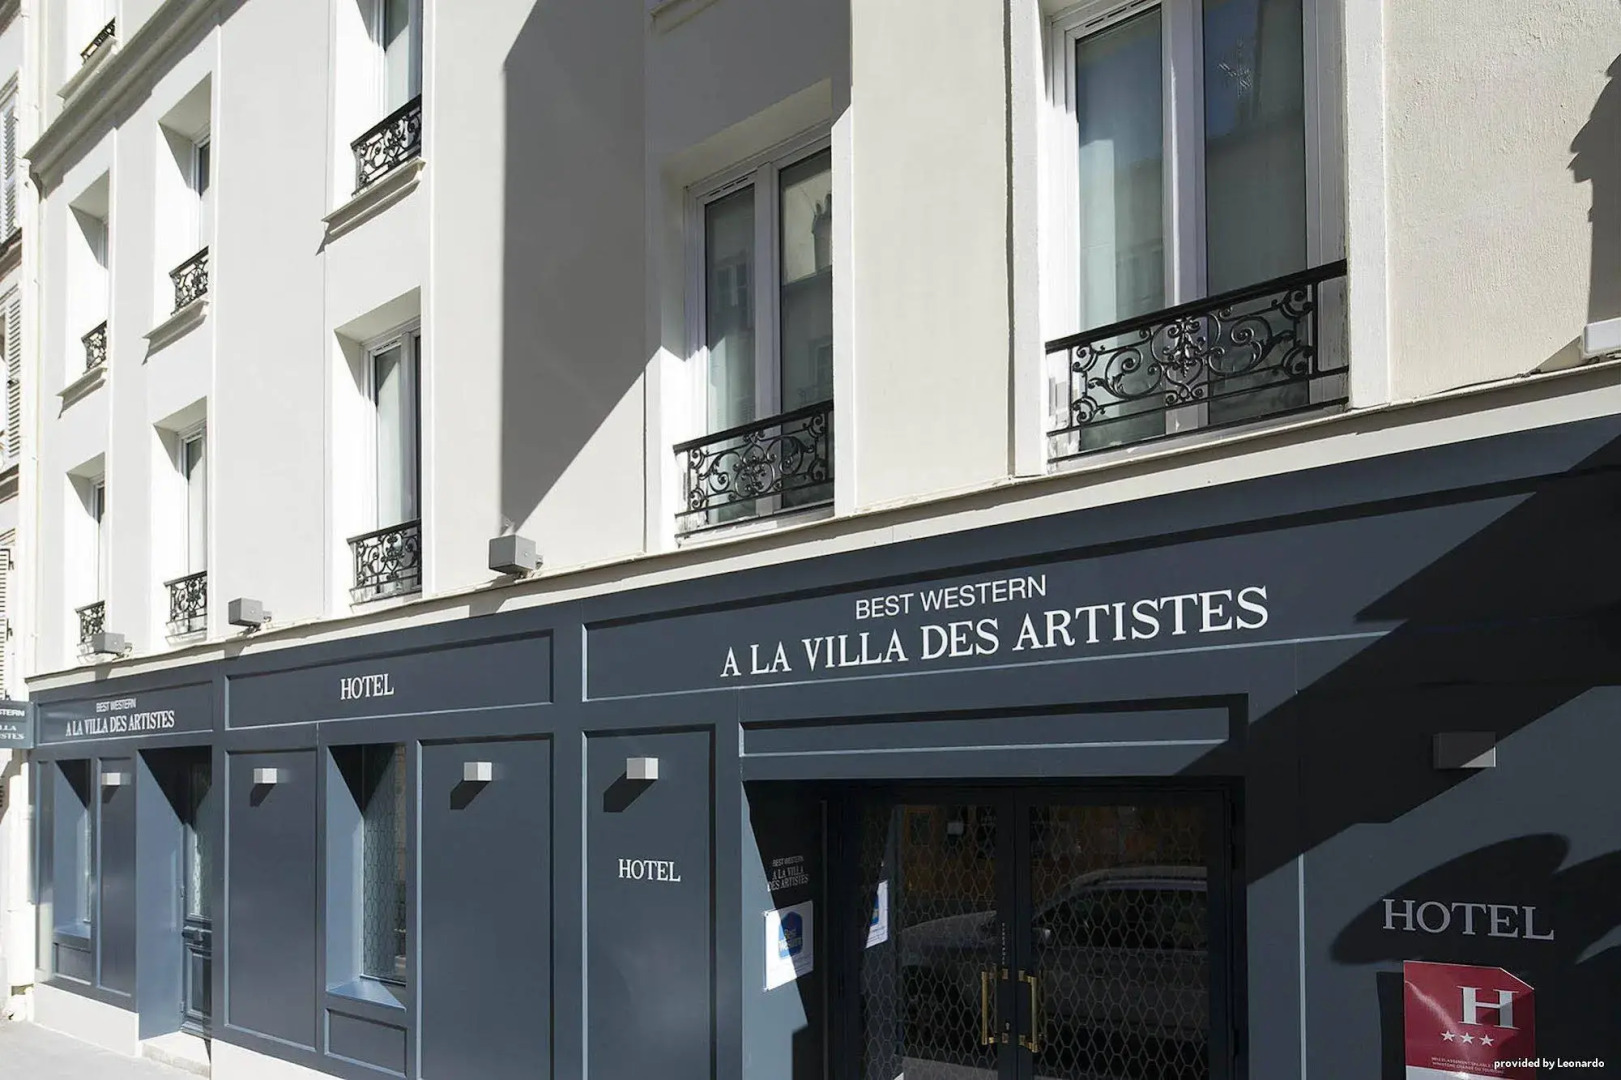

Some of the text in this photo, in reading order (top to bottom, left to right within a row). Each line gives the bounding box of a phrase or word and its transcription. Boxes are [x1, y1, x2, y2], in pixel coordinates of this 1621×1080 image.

[856, 574, 1046, 620] BEST WESTERN
[720, 585, 1269, 677] A LA VILLA DES ARTISTES
[340, 673, 395, 700] HOTEL
[95, 698, 137, 713] BEST WESTERN
[65, 710, 175, 737] A LA VILLA DES ARTISTES
[618, 858, 681, 882] HOTEL
[780, 873, 809, 889] ARTISTES
[787, 864, 805, 877] VILLA
[1382, 898, 1554, 940] HOTEL
[1456, 985, 1521, 1030] H
